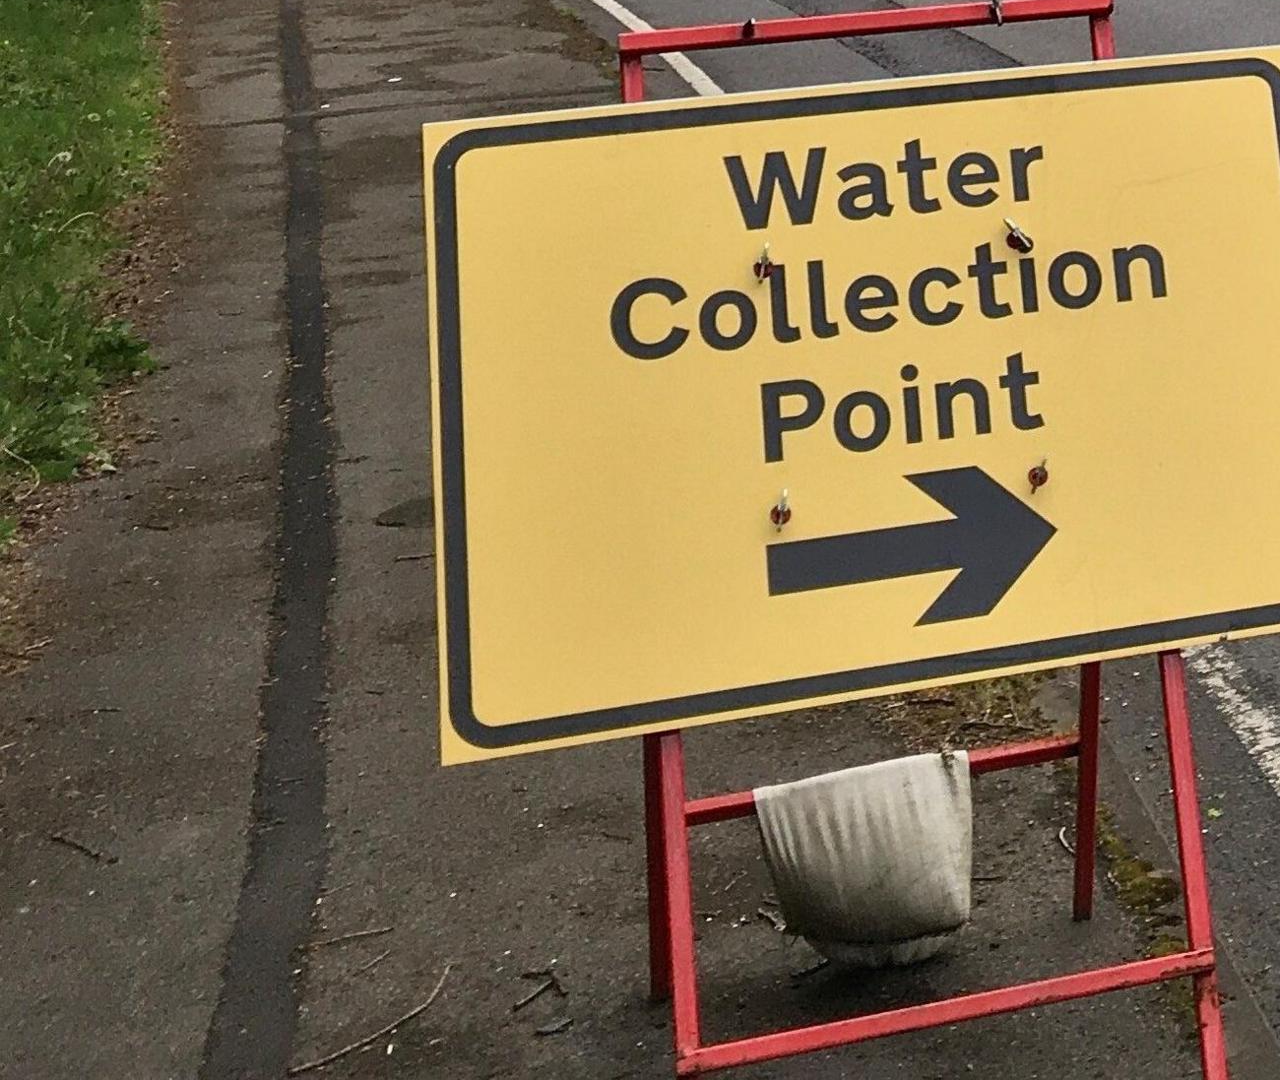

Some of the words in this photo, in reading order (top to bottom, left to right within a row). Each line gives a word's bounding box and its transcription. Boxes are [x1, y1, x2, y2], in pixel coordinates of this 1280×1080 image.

[724, 136, 1046, 231] Water
[609, 242, 1169, 361] Collection
[760, 352, 1045, 464] Point
